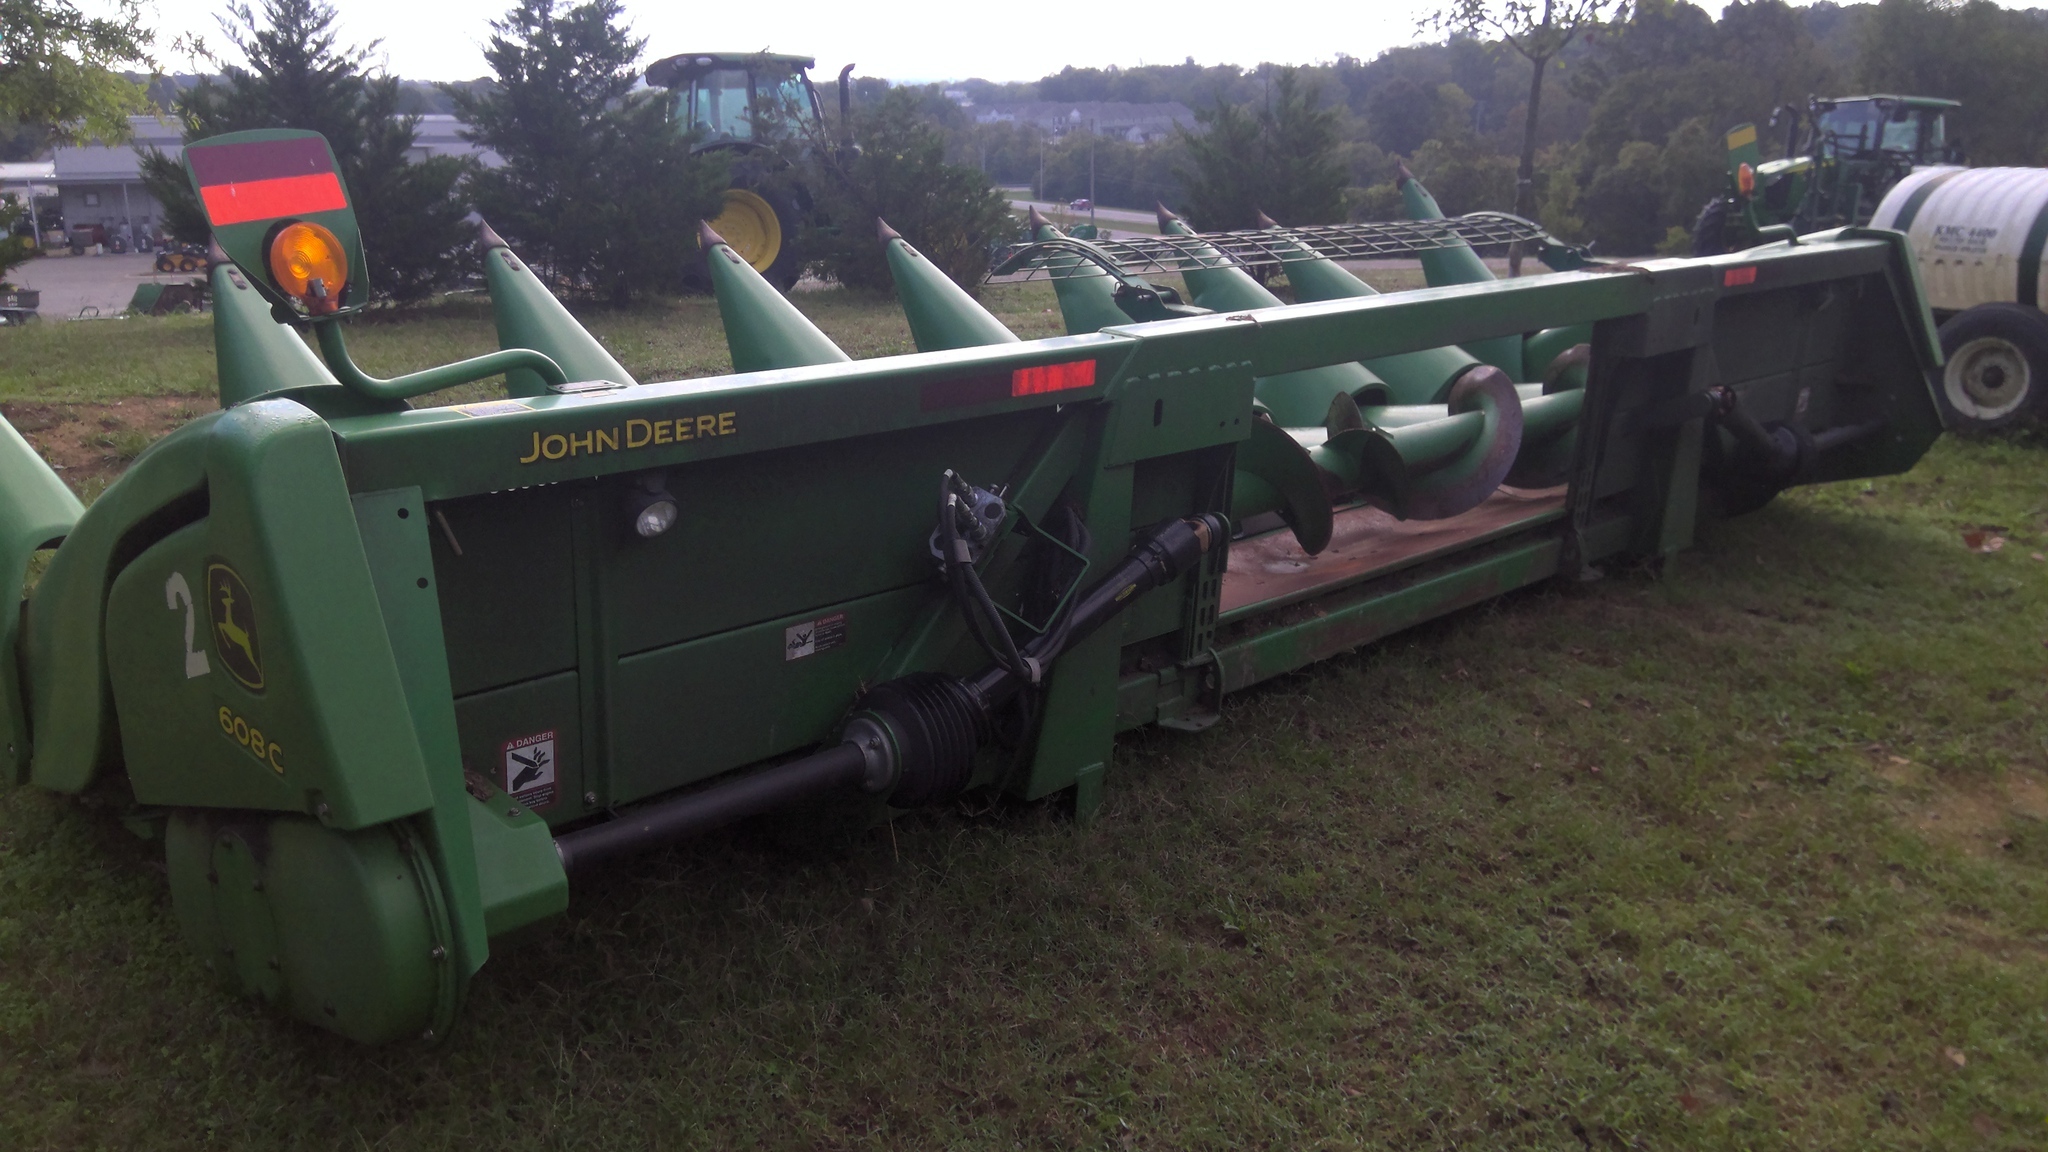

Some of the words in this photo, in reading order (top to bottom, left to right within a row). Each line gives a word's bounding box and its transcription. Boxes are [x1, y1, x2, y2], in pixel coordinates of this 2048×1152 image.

[1934, 225, 1965, 237] KMC
[520, 426, 619, 464] JOHN
[626, 411, 736, 449] DEERE
[165, 571, 211, 679] 2
[219, 706, 284, 774] 608C
[516, 731, 554, 748] DANGER
